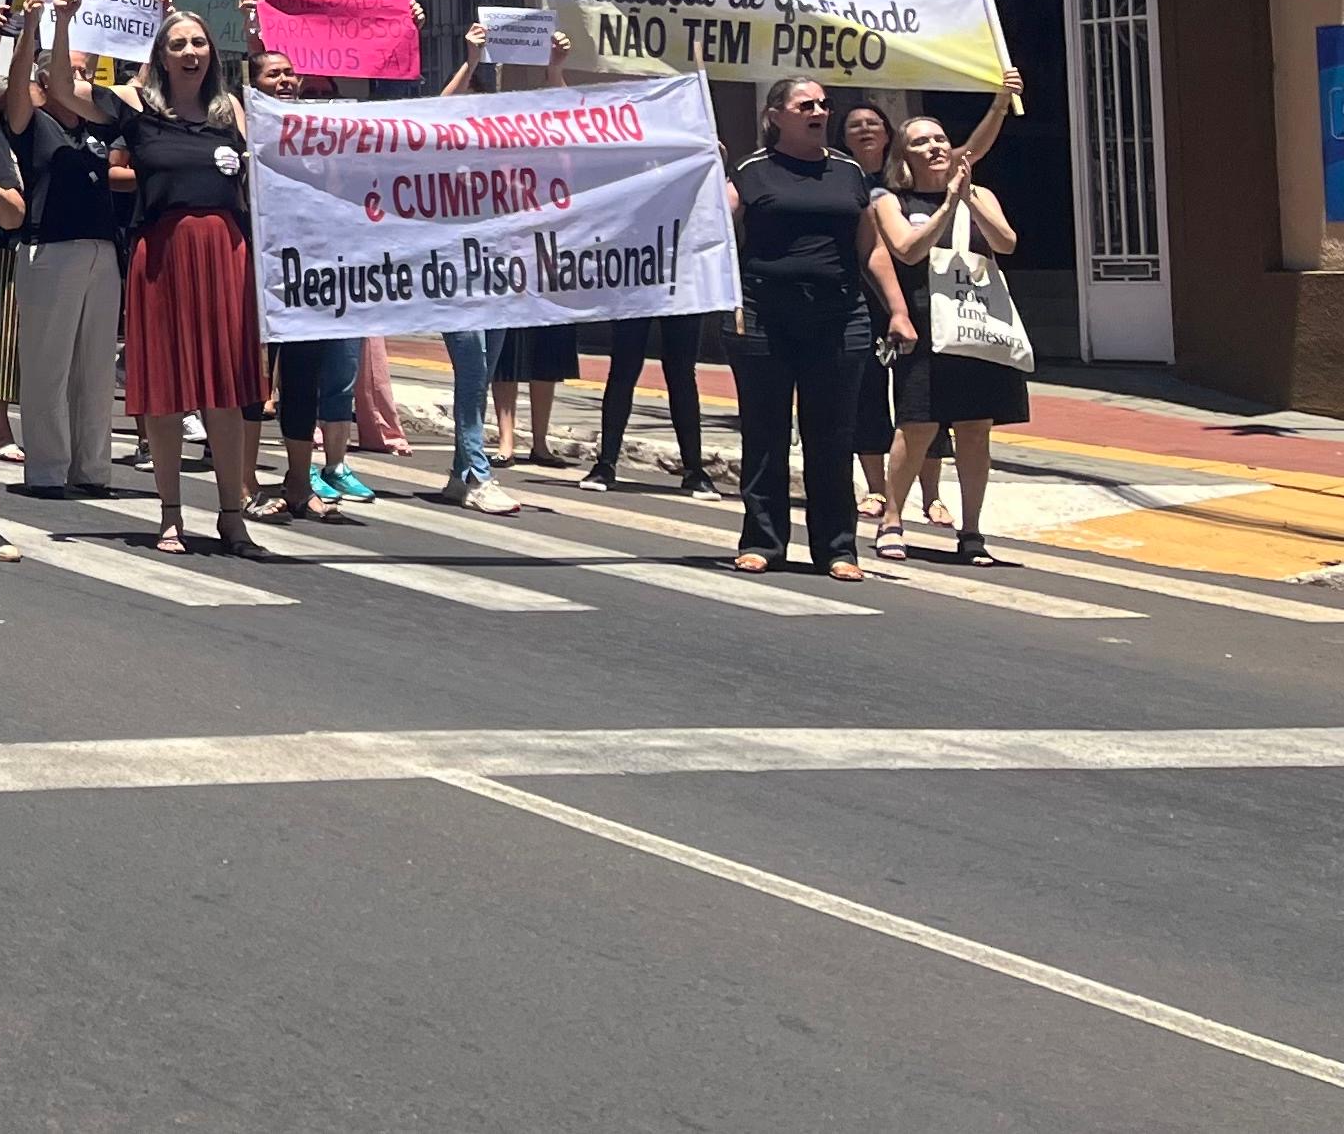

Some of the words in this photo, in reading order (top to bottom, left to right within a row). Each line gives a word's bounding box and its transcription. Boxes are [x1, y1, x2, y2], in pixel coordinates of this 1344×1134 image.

[82, 11, 155, 38] GABINETE!
[265, 16, 313, 39] PARA
[328, 16, 416, 40] NOSSOS
[598, 7, 667, 59] NÃO
[682, 18, 752, 64] TEM
[772, 22, 888, 77] PREÇO
[279, 112, 427, 157] RESPEITO
[435, 122, 469, 152] AO
[467, 99, 645, 151] MAGISTÉRIO
[392, 166, 540, 219] CUMPRIR
[282, 246, 414, 318] Reajuste
[422, 248, 457, 299] do
[462, 236, 528, 297] Piso
[535, 218, 681, 297] Nacional!
